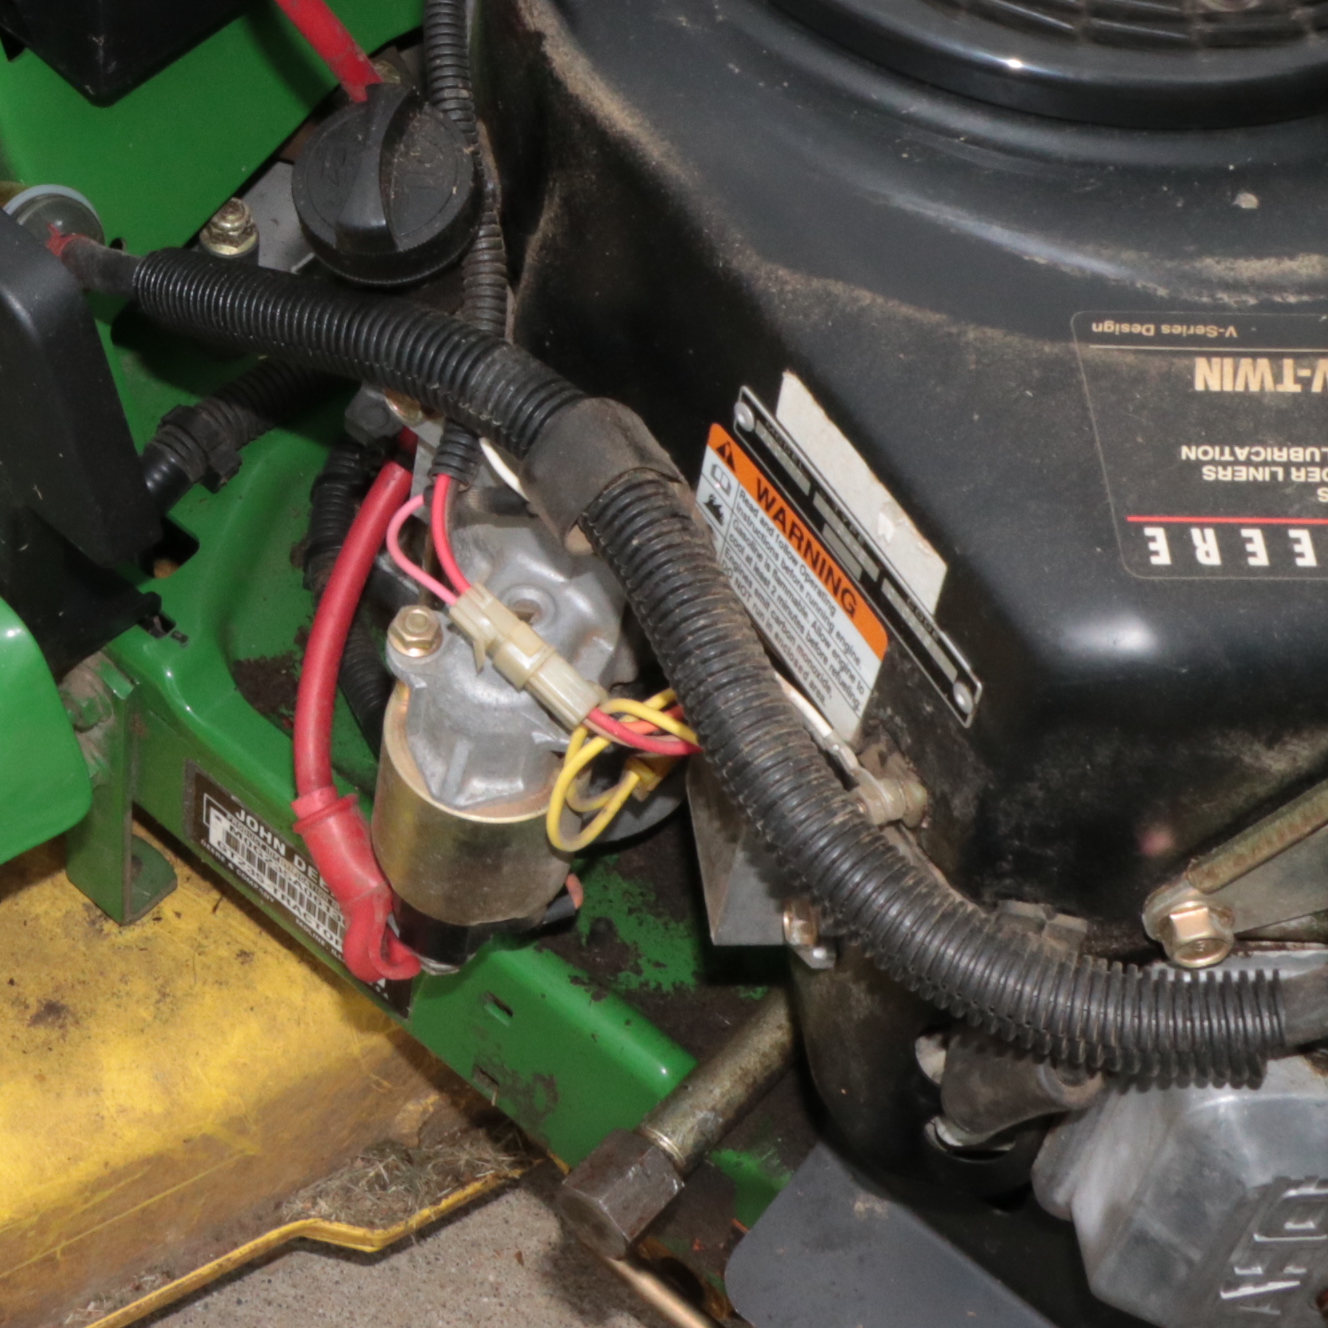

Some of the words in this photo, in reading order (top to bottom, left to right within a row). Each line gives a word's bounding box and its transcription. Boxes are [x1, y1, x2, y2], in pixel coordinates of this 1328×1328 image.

[1090, 320, 1155, 336] Design
[1159, 322, 1238, 338] V-Series
[1193, 356, 1328, 394] V-TWIN
[1201, 465, 1284, 483] LINERS
[729, 533, 743, 555] cool
[745, 553, 753, 566] at
[753, 562, 770, 588] least
[770, 584, 776, 596] 2
[777, 594, 804, 633] minutes
[805, 630, 828, 665] before
[733, 518, 762, 562] Gasoline
[763, 557, 771, 572] is
[772, 568, 810, 622] flammable.
[812, 620, 830, 649] Allow
[830, 648, 854, 685] engine
[855, 679, 865, 696] to
[736, 502, 778, 562] Instructions
[780, 558, 803, 592] before
[804, 591, 833, 634] running
[835, 630, 862, 670] engine.
[739, 489, 758, 517] Read
[760, 515, 773, 536] and
[774, 533, 797, 566] follow
[798, 563, 836, 617] Operating
[753, 476, 858, 618] WARNING
[724, 547, 752, 589] Engines
[755, 586, 770, 611] emit
[771, 608, 795, 645] carbon
[796, 643, 834, 698] monoxide,
[734, 576, 750, 602] NOT
[753, 602, 764, 621] run
[764, 617, 774, 633] in
[773, 631, 808, 680] enclosed
[809, 679, 826, 706] area.
[217, 839, 263, 884] GT235
[238, 806, 285, 856] JOHN
[294, 853, 333, 897] DEE
